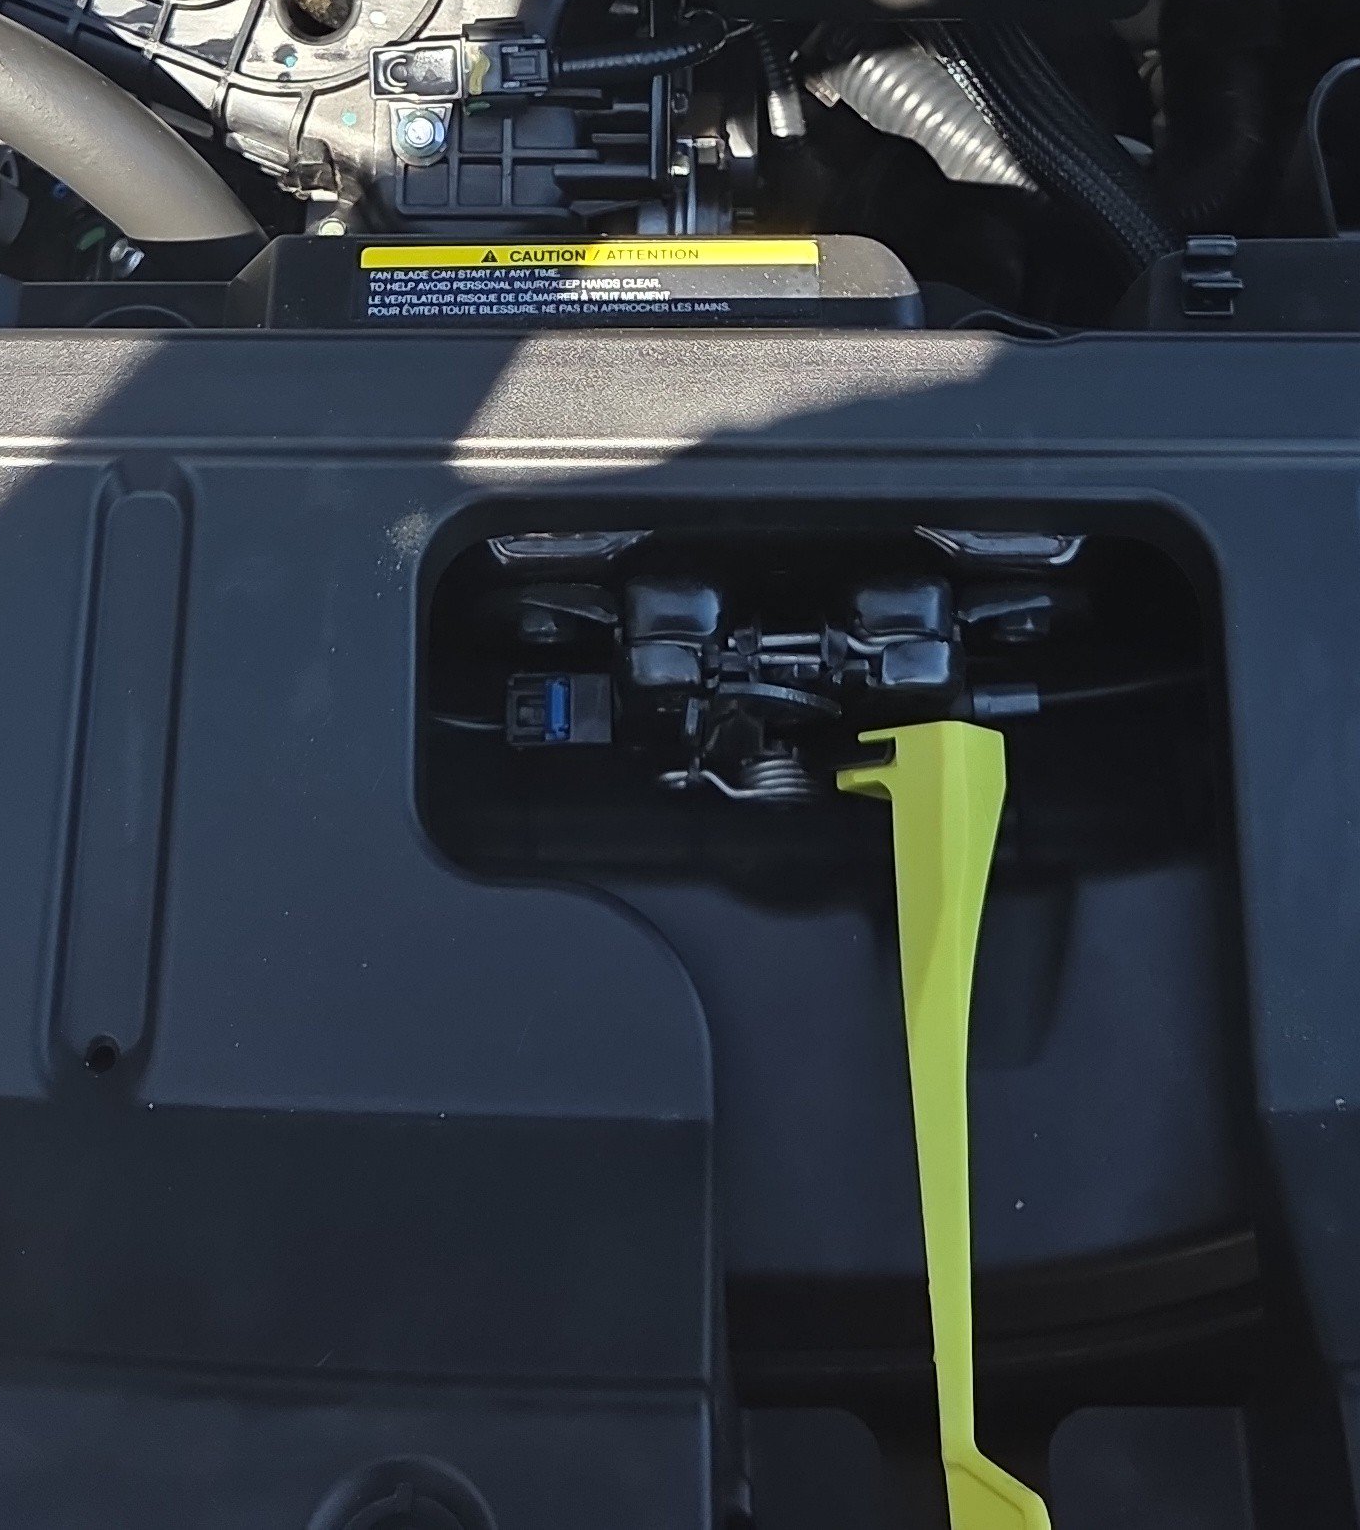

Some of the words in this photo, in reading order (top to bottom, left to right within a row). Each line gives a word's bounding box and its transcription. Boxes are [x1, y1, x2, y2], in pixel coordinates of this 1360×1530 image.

[509, 249, 586, 263] CAUTION
[606, 248, 699, 261] ATTENTION
[369, 271, 391, 280] FAN
[393, 270, 429, 280] BLADE
[431, 270, 455, 279] CAN
[457, 269, 490, 279] START
[493, 269, 507, 279] AT
[508, 269, 531, 278] ANY
[533, 268, 560, 278] TIME.
[369, 281, 385, 292] TO
[387, 281, 415, 291] HELP
[416, 281, 451, 291] AVOID
[452, 280, 512, 290] PERSONAL
[582, 279, 620, 289] HANDS
[622, 278, 661, 289] CLEAR.
[368, 295, 381, 304] LE
[384, 294, 455, 304] VENTILATEUR
[457, 293, 497, 303] RISQUE
[500, 292, 516, 302] DE
[518, 290, 578, 302] DÉMARRER
[590, 291, 619, 301] TOUT
[368, 306, 399, 316] POUR
[402, 303, 439, 315] ÉVITER
[441, 305, 478, 315] TOUTE
[541, 304, 557, 313] NE
[559, 303, 581, 313] PAS
[583, 303, 598, 313] EN
[600, 302, 669, 312] APPROCHER
[671, 302, 692, 312] LES
[694, 301, 731, 311] MAINS.
